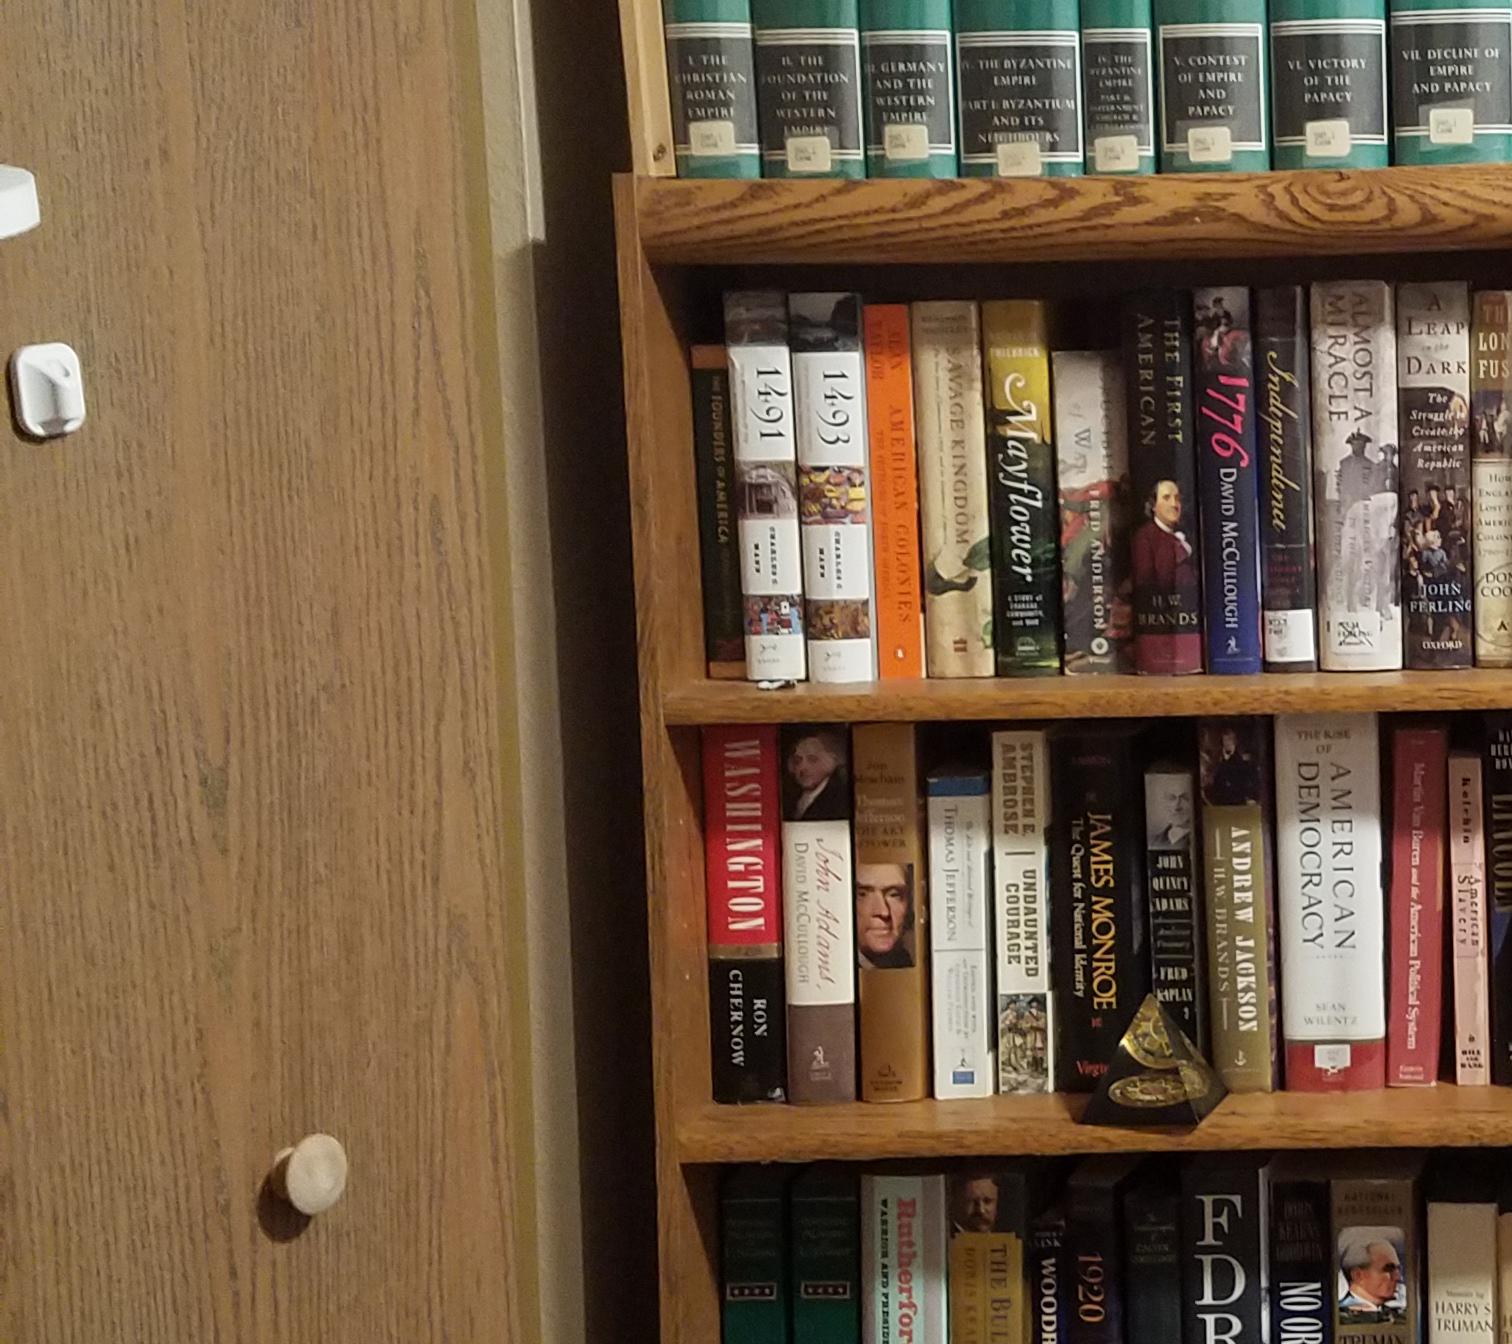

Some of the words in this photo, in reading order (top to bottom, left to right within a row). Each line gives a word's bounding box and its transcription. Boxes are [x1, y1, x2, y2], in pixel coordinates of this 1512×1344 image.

[1325, 294, 1348, 423] MIRACLE
[1406, 319, 1466, 337] LEAP
[1406, 355, 1468, 376] DARK
[756, 366, 789, 440] 1491
[823, 370, 854, 446] 1493
[1200, 374, 1250, 468] 1776
[1003, 372, 1051, 583] Mayflower
[1090, 537, 1105, 630] ANDERSON
[1409, 597, 1472, 614] FERLING
[1422, 583, 1462, 597] JOHN
[1001, 743, 1021, 835] AMBROSE
[724, 739, 766, 932] WASHINGTON
[1087, 811, 1114, 888] JAMES
[1230, 826, 1254, 923] ANDREW
[1297, 763, 1325, 949] DEMOCRACY
[1330, 762, 1356, 951] AMERICAN
[1005, 882, 1021, 966] COURAGE
[1021, 868, 1039, 978] UNDAUNTED
[1090, 895, 1118, 1011] MONROE
[728, 969, 745, 1067] CHERNOW
[753, 998, 768, 1037] RON
[1235, 935, 1259, 1033] JACKSON
[1077, 1253, 1106, 1323] 1920
[1278, 1281, 1322, 1311] NO
